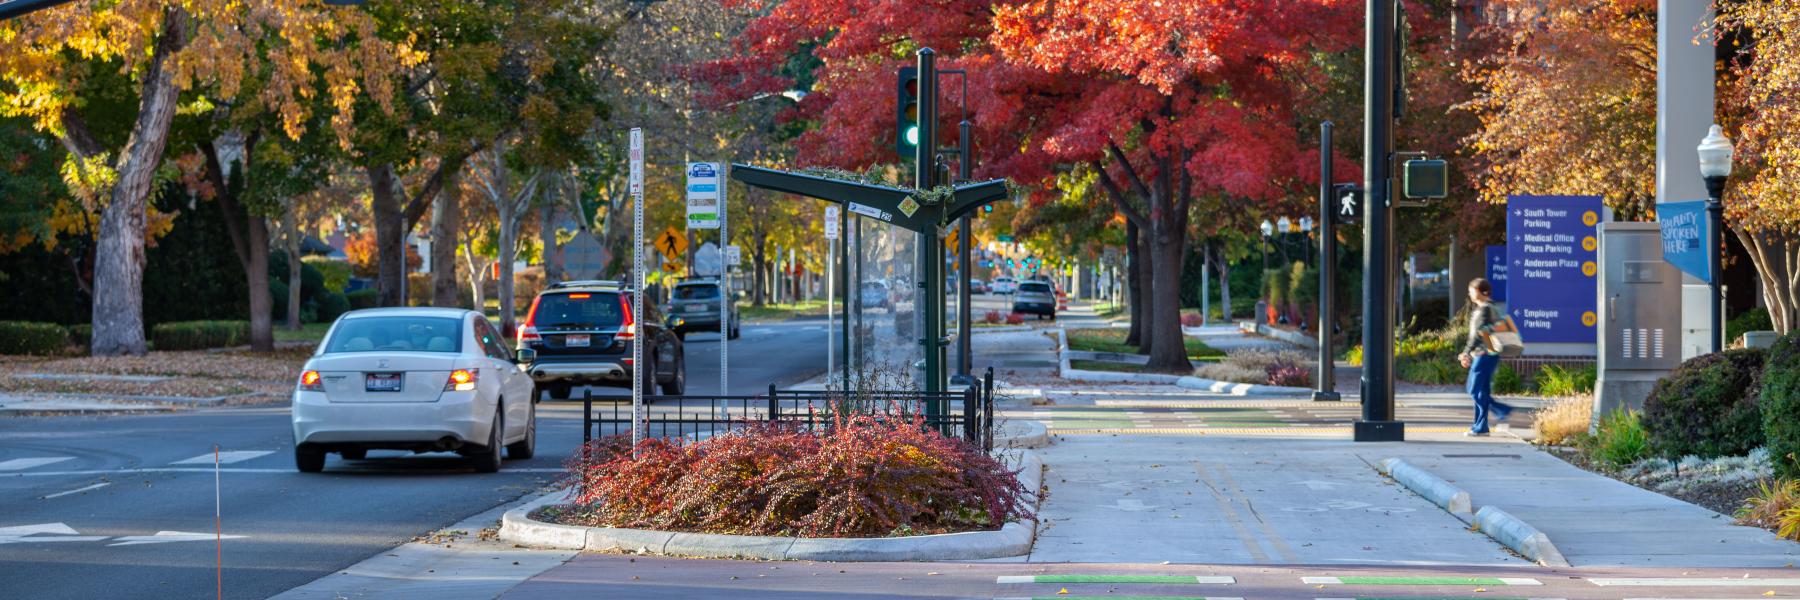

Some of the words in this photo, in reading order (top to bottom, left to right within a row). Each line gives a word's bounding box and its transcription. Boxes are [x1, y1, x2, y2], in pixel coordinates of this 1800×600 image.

[1524, 209, 1544, 217] South
[1546, 209, 1567, 217] Tower
[1524, 220, 1551, 229] Parking
[1661, 211, 1698, 229] QUALITY
[1524, 234, 1552, 242] Medical
[1554, 234, 1574, 242] Office
[1662, 227, 1698, 240] SPOKEN
[1524, 245, 1544, 253] Plaza
[1545, 245, 1572, 254] Parking
[1664, 239, 1688, 254] HERE
[1524, 259, 1557, 267] Anderson
[1559, 259, 1578, 267] Plaza
[1524, 270, 1551, 279] Parking
[1524, 309, 1558, 319] Employee
[1524, 320, 1551, 329] Parking
